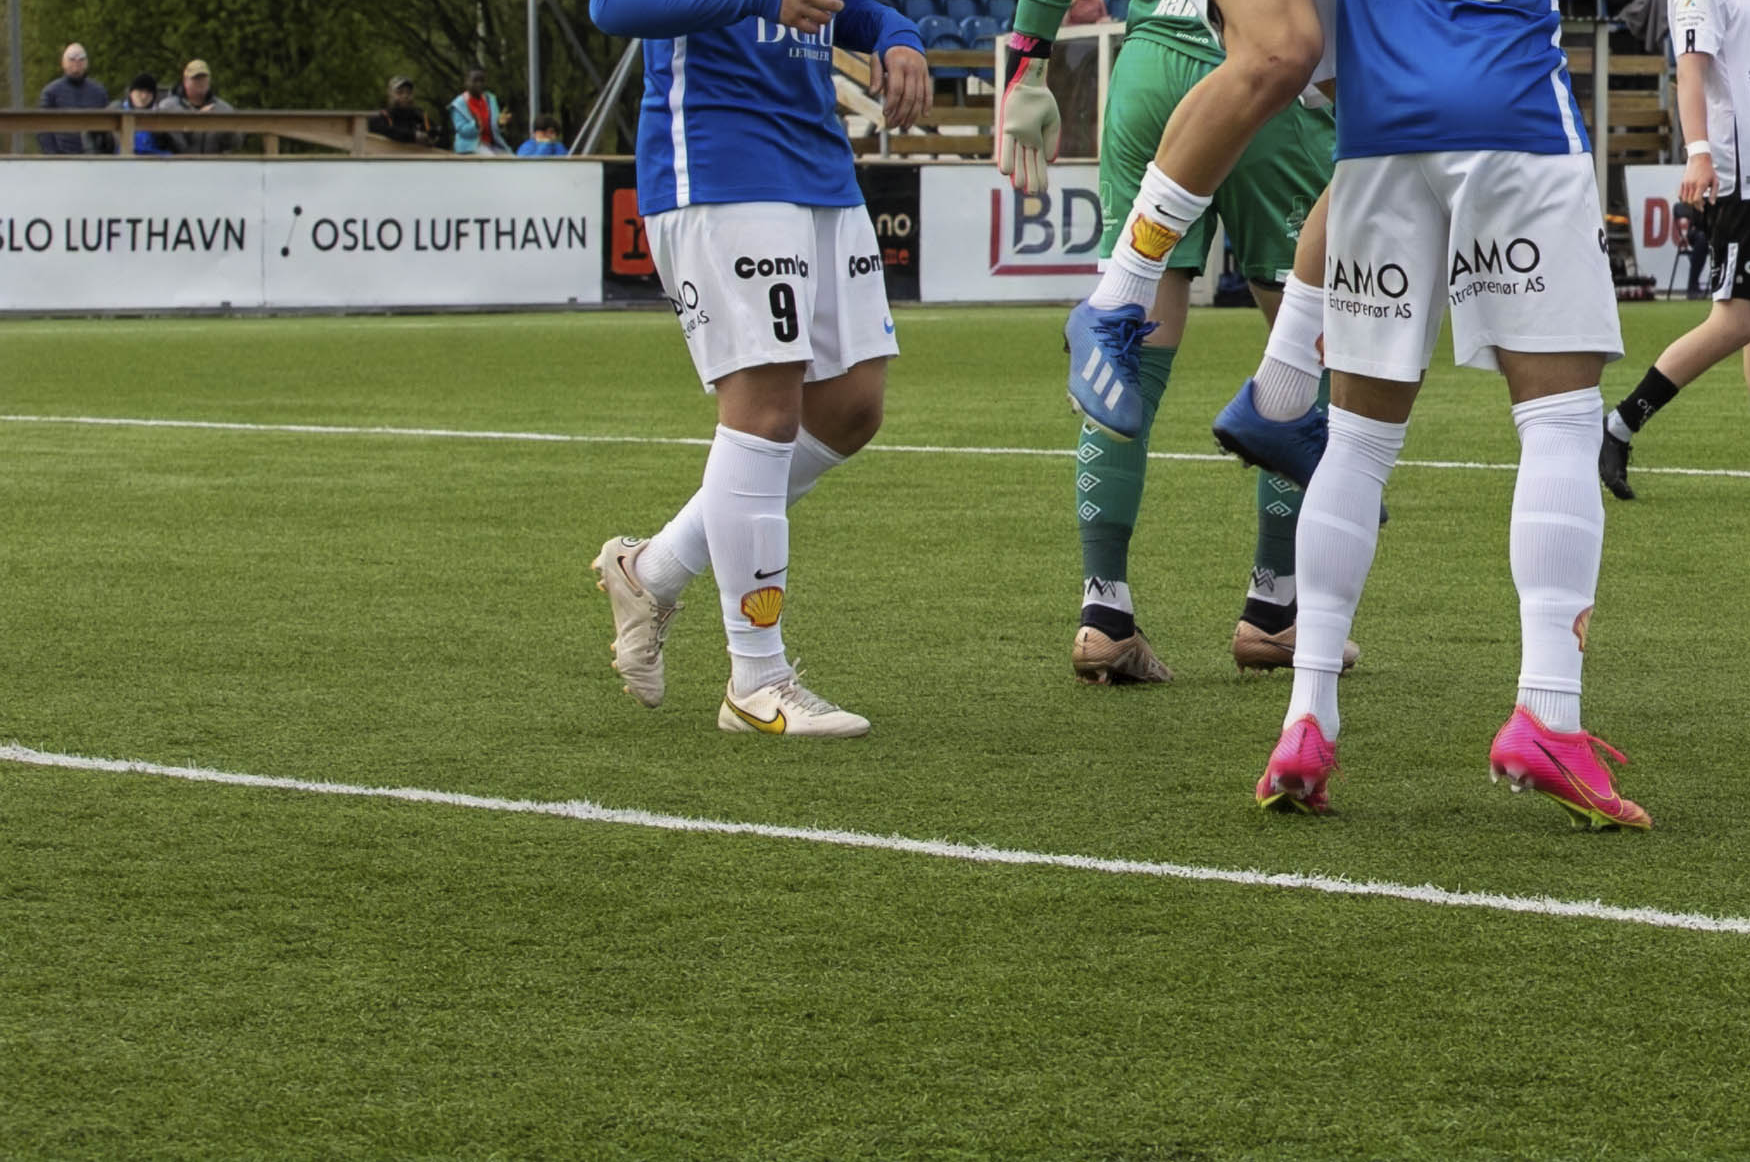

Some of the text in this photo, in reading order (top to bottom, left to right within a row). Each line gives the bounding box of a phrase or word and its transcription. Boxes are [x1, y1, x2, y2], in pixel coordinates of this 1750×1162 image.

[65, 217, 246, 252] LUFTHAVN
[311, 216, 588, 251] OSLO LUFTHAVN
[1328, 255, 1409, 299] AMO
[1449, 276, 1546, 306] ntreprenør AS
[768, 282, 799, 343] 9
[1395, 303, 1412, 319] AS
